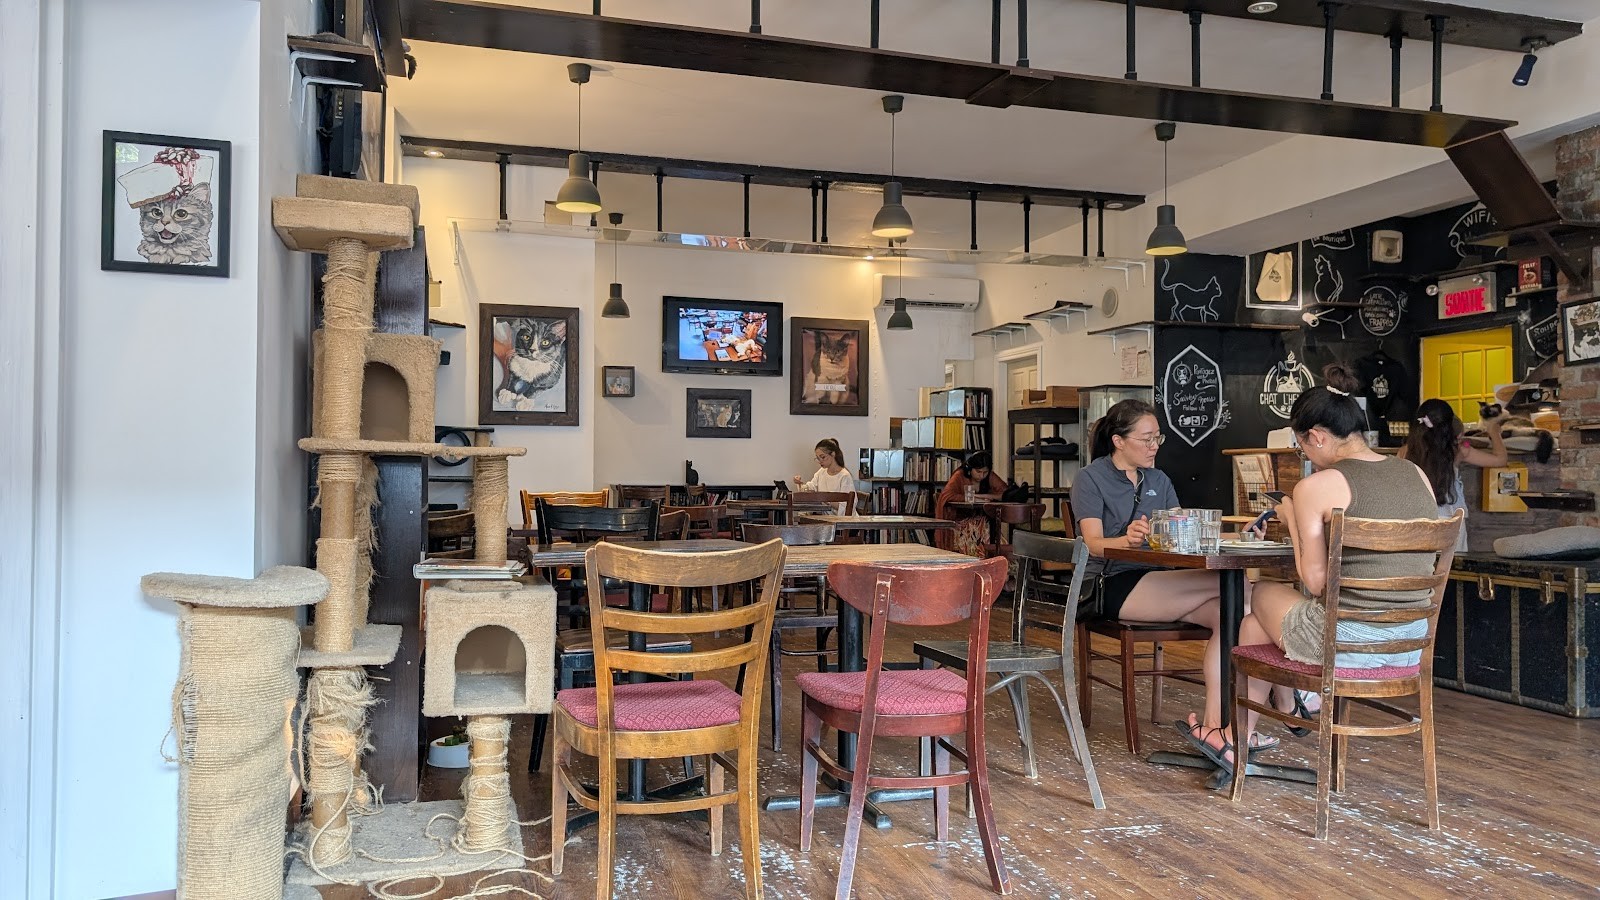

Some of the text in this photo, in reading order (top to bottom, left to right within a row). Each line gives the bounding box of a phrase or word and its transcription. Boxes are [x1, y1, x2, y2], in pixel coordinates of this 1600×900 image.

[1463, 210, 1491, 227] WIFI
[1445, 287, 1486, 316] SORTIE
[1260, 393, 1278, 405] CHAT
